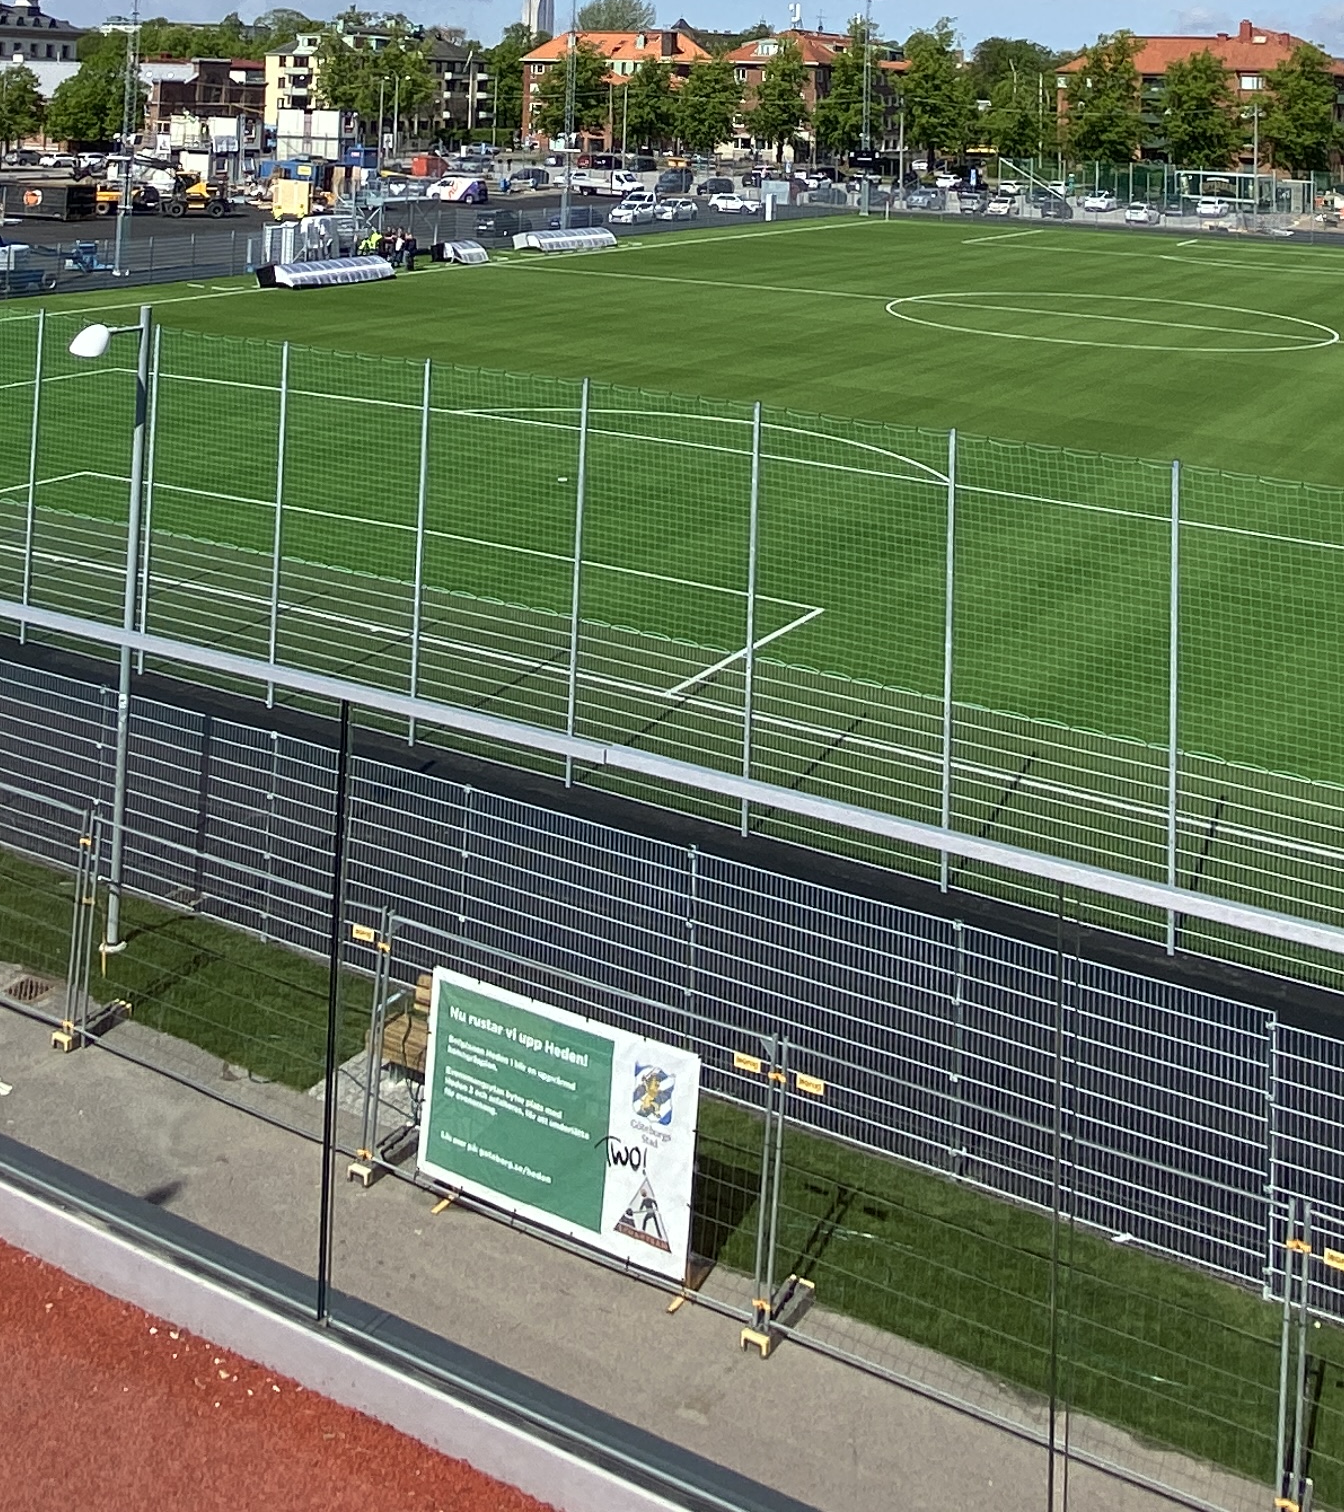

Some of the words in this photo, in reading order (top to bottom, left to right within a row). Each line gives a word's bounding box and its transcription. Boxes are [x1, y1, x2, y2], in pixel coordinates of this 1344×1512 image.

[450, 1006, 466, 1022] Nu
[468, 1014, 503, 1035] rustar
[506, 1027, 517, 1040] vi
[518, 1032, 543, 1051] upp
[544, 1040, 589, 1067] Heden!
